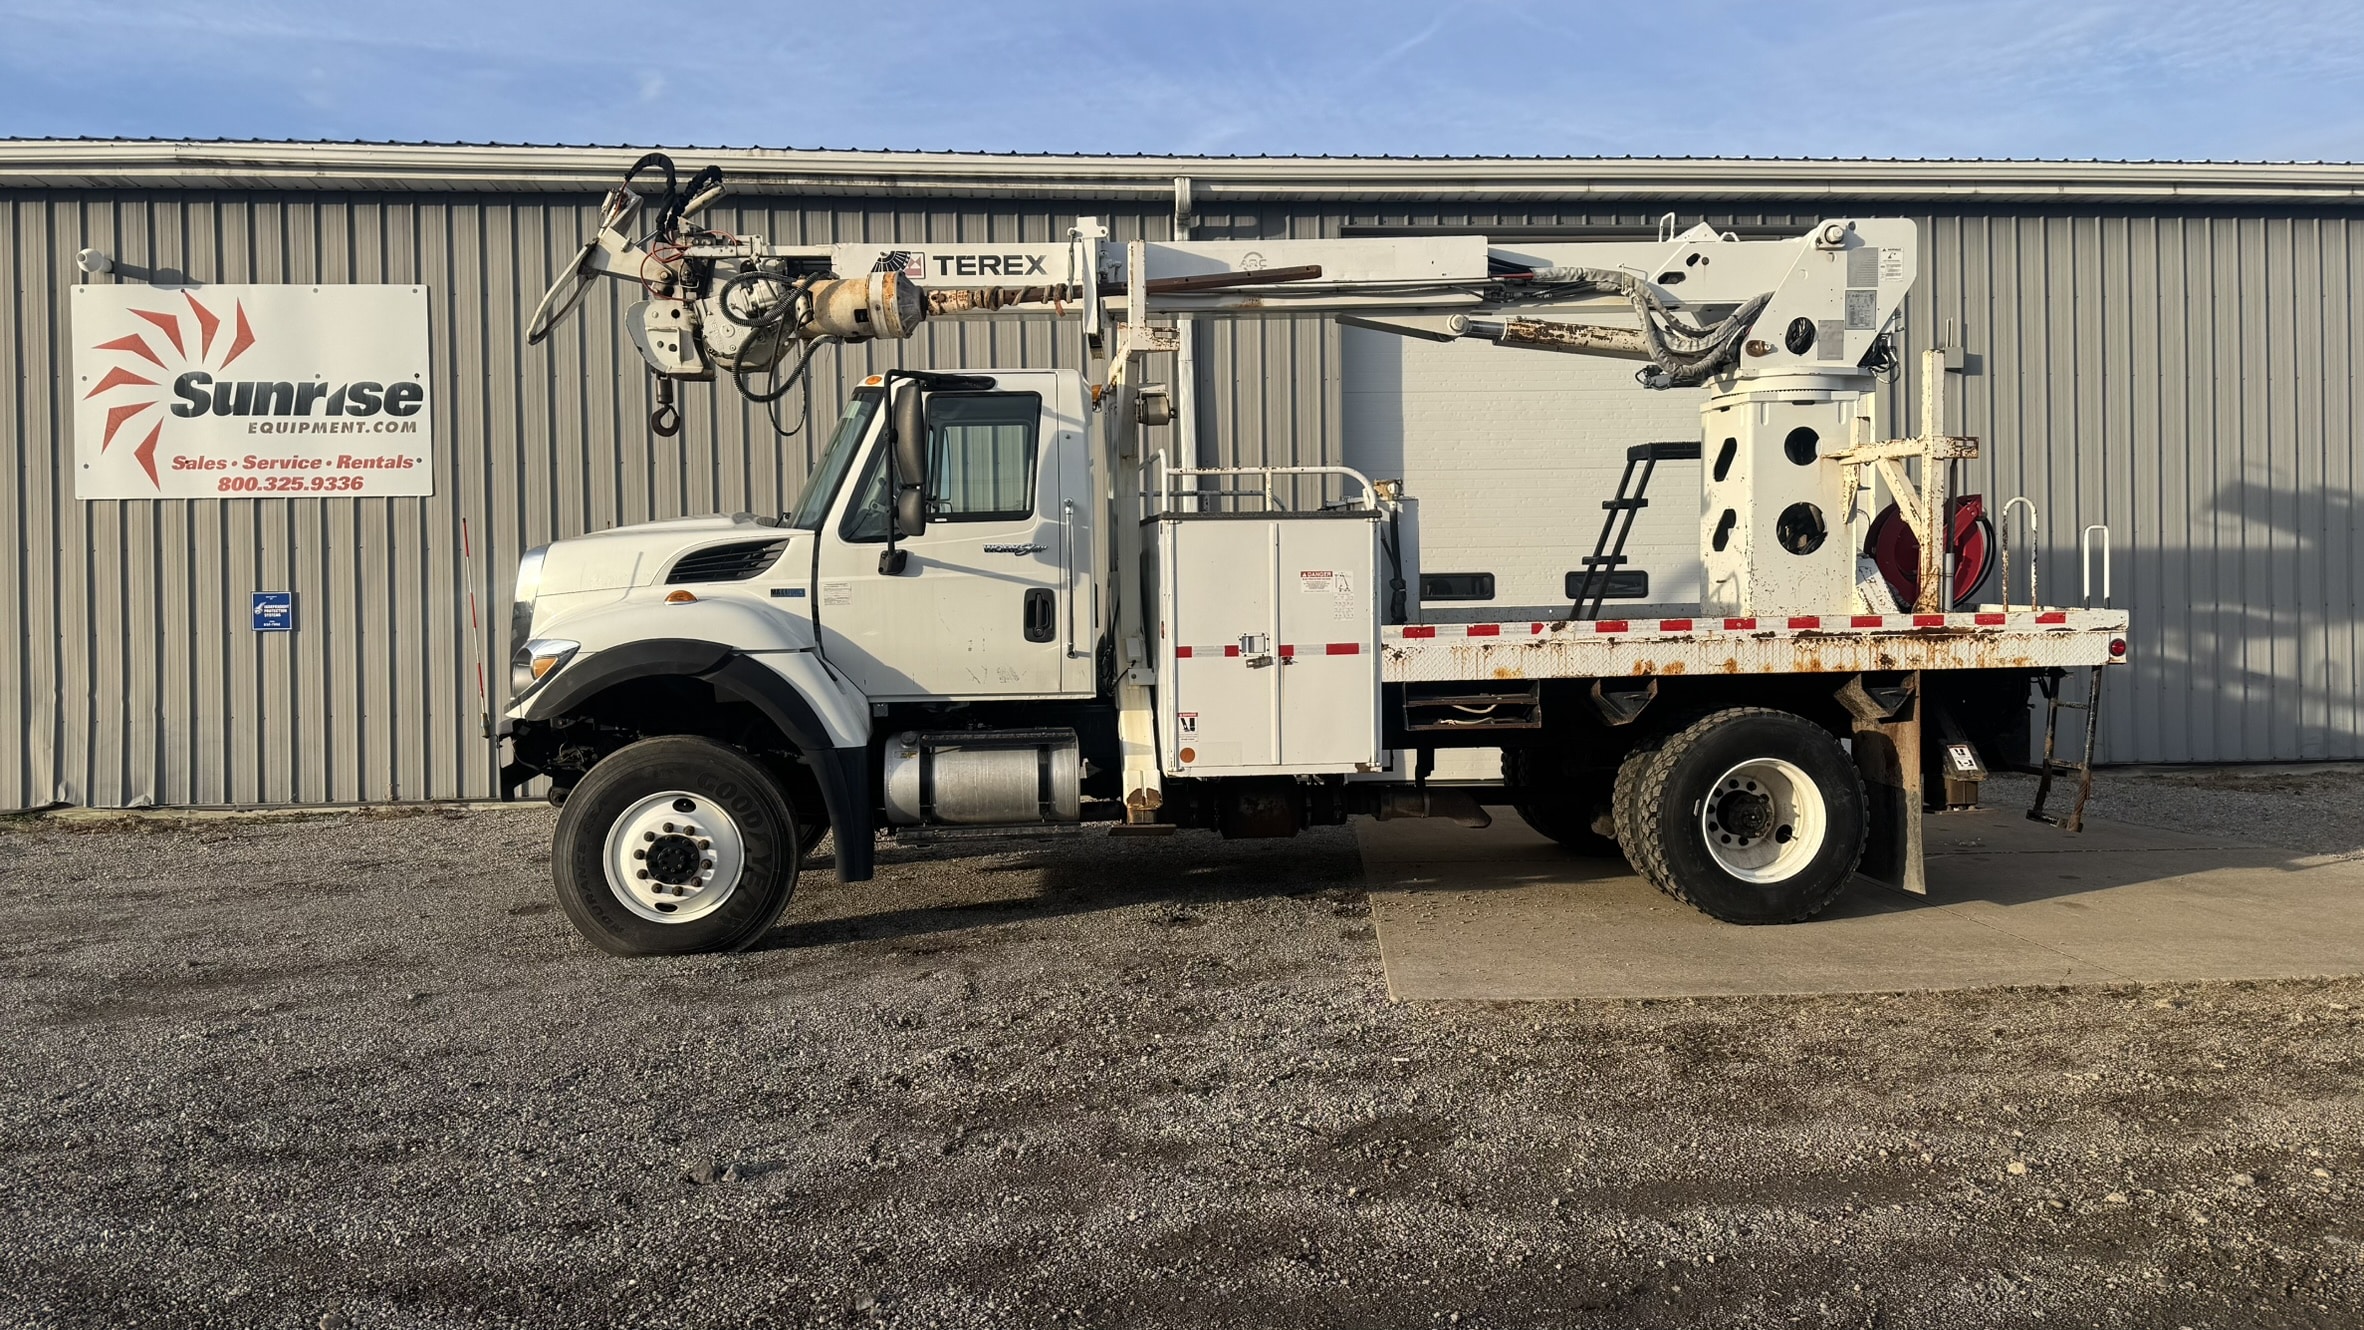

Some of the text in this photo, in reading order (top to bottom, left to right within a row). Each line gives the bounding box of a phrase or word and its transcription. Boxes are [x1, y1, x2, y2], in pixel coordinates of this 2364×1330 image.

[932, 254, 1048, 276] TEREX
[170, 371, 424, 418] Sunrise
[247, 421, 418, 434] EQUIPMENT.COM
[171, 454, 415, 470] Sales Service Rentals
[217, 475, 364, 492] 800.325.9336
